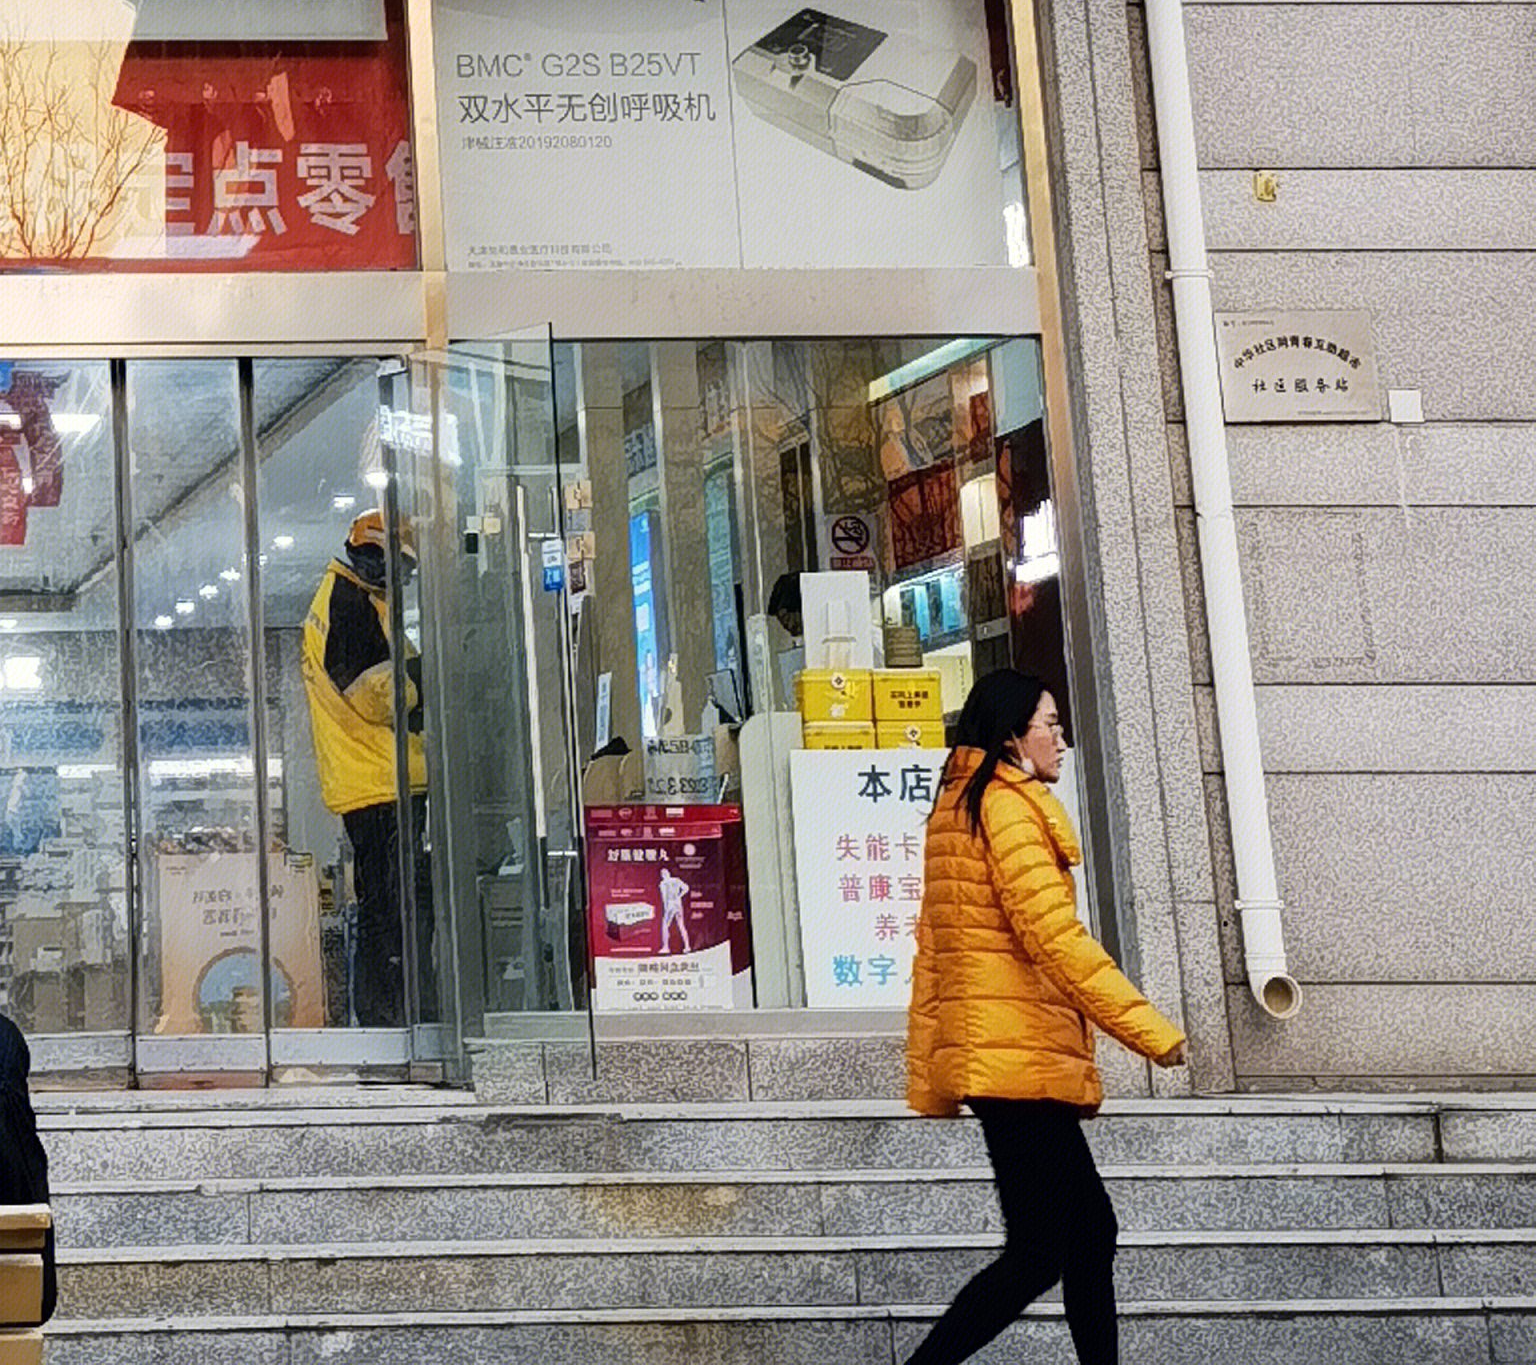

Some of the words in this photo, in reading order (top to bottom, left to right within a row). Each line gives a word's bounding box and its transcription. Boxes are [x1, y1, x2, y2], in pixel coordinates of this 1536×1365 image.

[541, 53, 601, 78] G2S
[609, 52, 702, 77] B25VT
[458, 92, 717, 124] 双水平无创呼吸机
[858, 764, 944, 803] 本店
[836, 833, 920, 862] 失能卡
[833, 954, 913, 986] 数字
